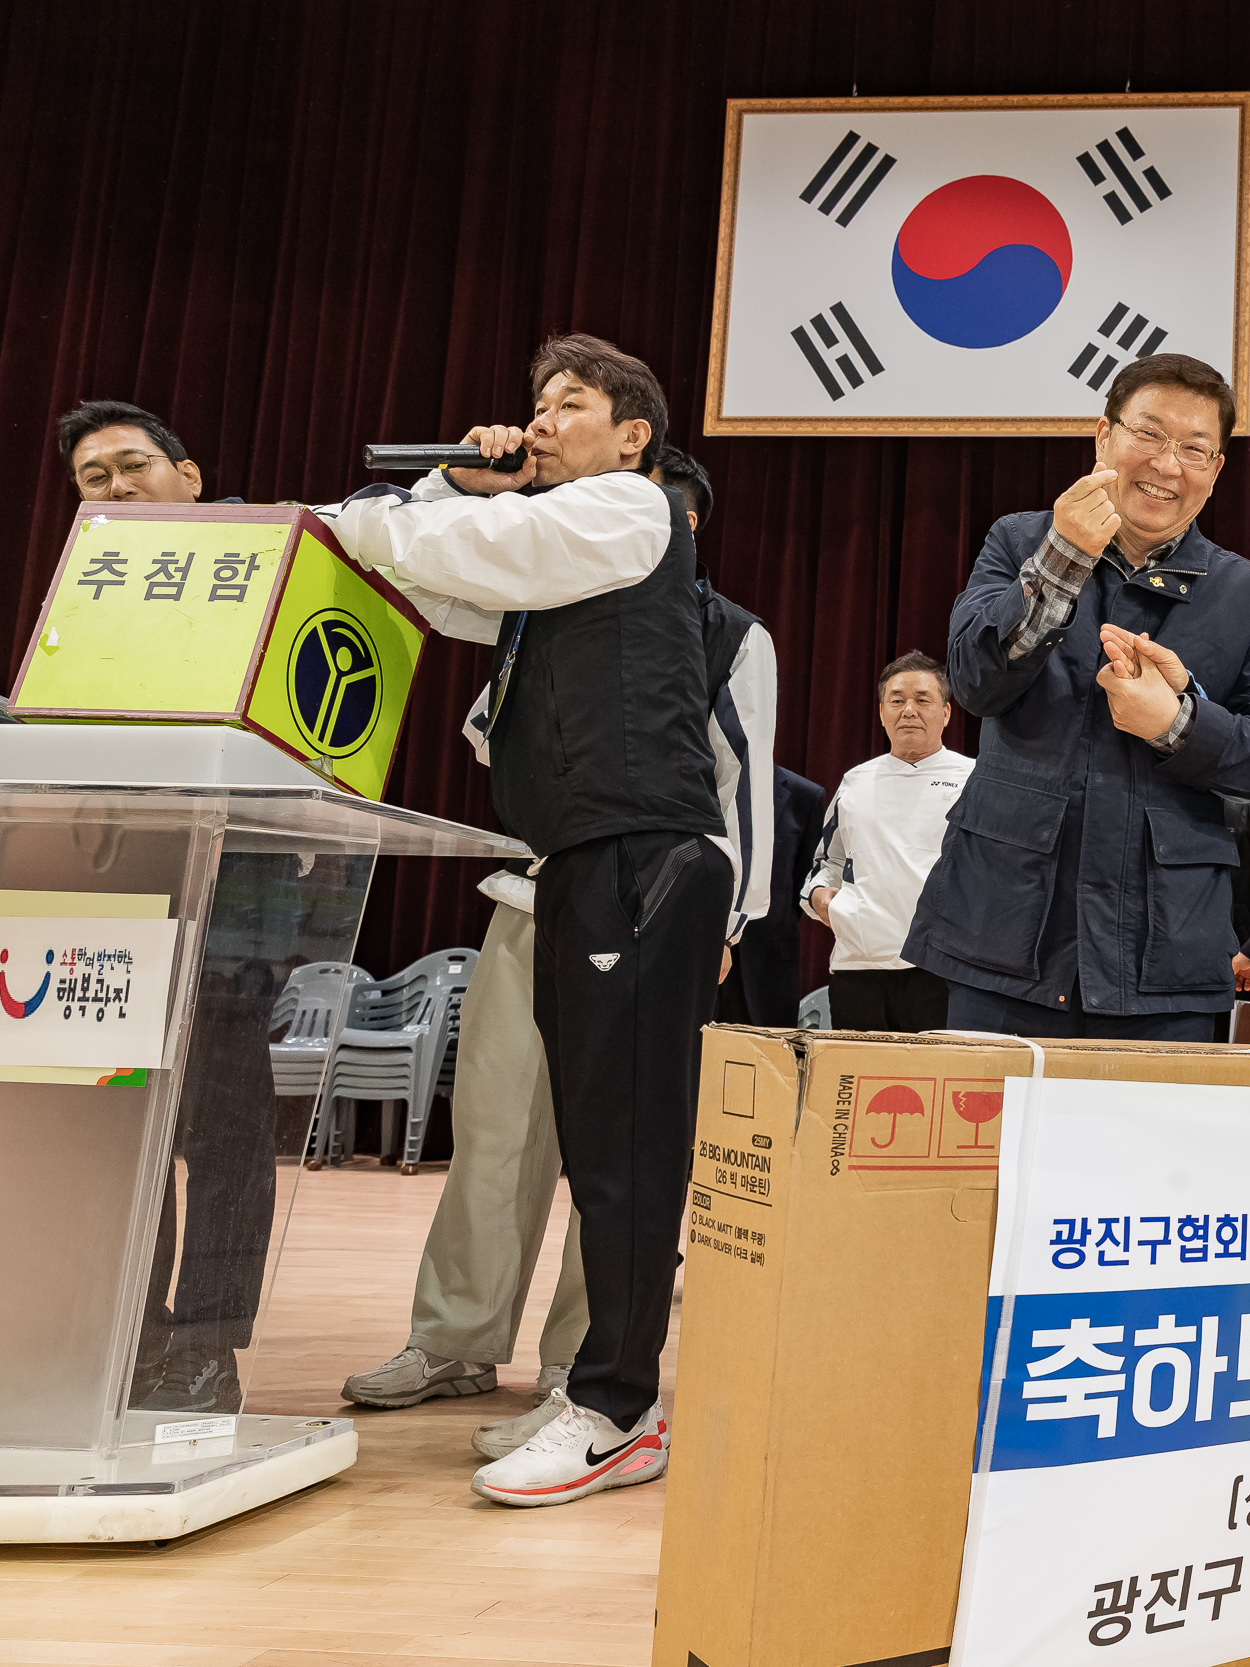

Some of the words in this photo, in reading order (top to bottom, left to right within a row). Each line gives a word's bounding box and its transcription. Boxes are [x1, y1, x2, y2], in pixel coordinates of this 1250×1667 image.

[60, 947, 95, 975] 소통하며
[97, 949, 133, 974] 발전하는
[57, 973, 131, 1022] 행복광진
[837, 1074, 855, 1106] MADE
[834, 1108, 850, 1120] IN
[830, 1122, 848, 1159] CHINA
[699, 1140, 707, 1158] 26
[708, 1143, 721, 1162] BIG
[722, 1147, 771, 1174] MOUNTAIN
[715, 1166, 728, 1185] (26
[730, 1171, 738, 1189] 빅
[741, 1174, 770, 1197] 마운틴)
[693, 1191, 711, 1210] COLOR
[699, 1214, 716, 1229] BLACK
[717, 1219, 733, 1236] MATT
[697, 1232, 712, 1248] DARK
[713, 1238, 733, 1256] SILVER
[1087, 1556, 1244, 1647] 광진구
